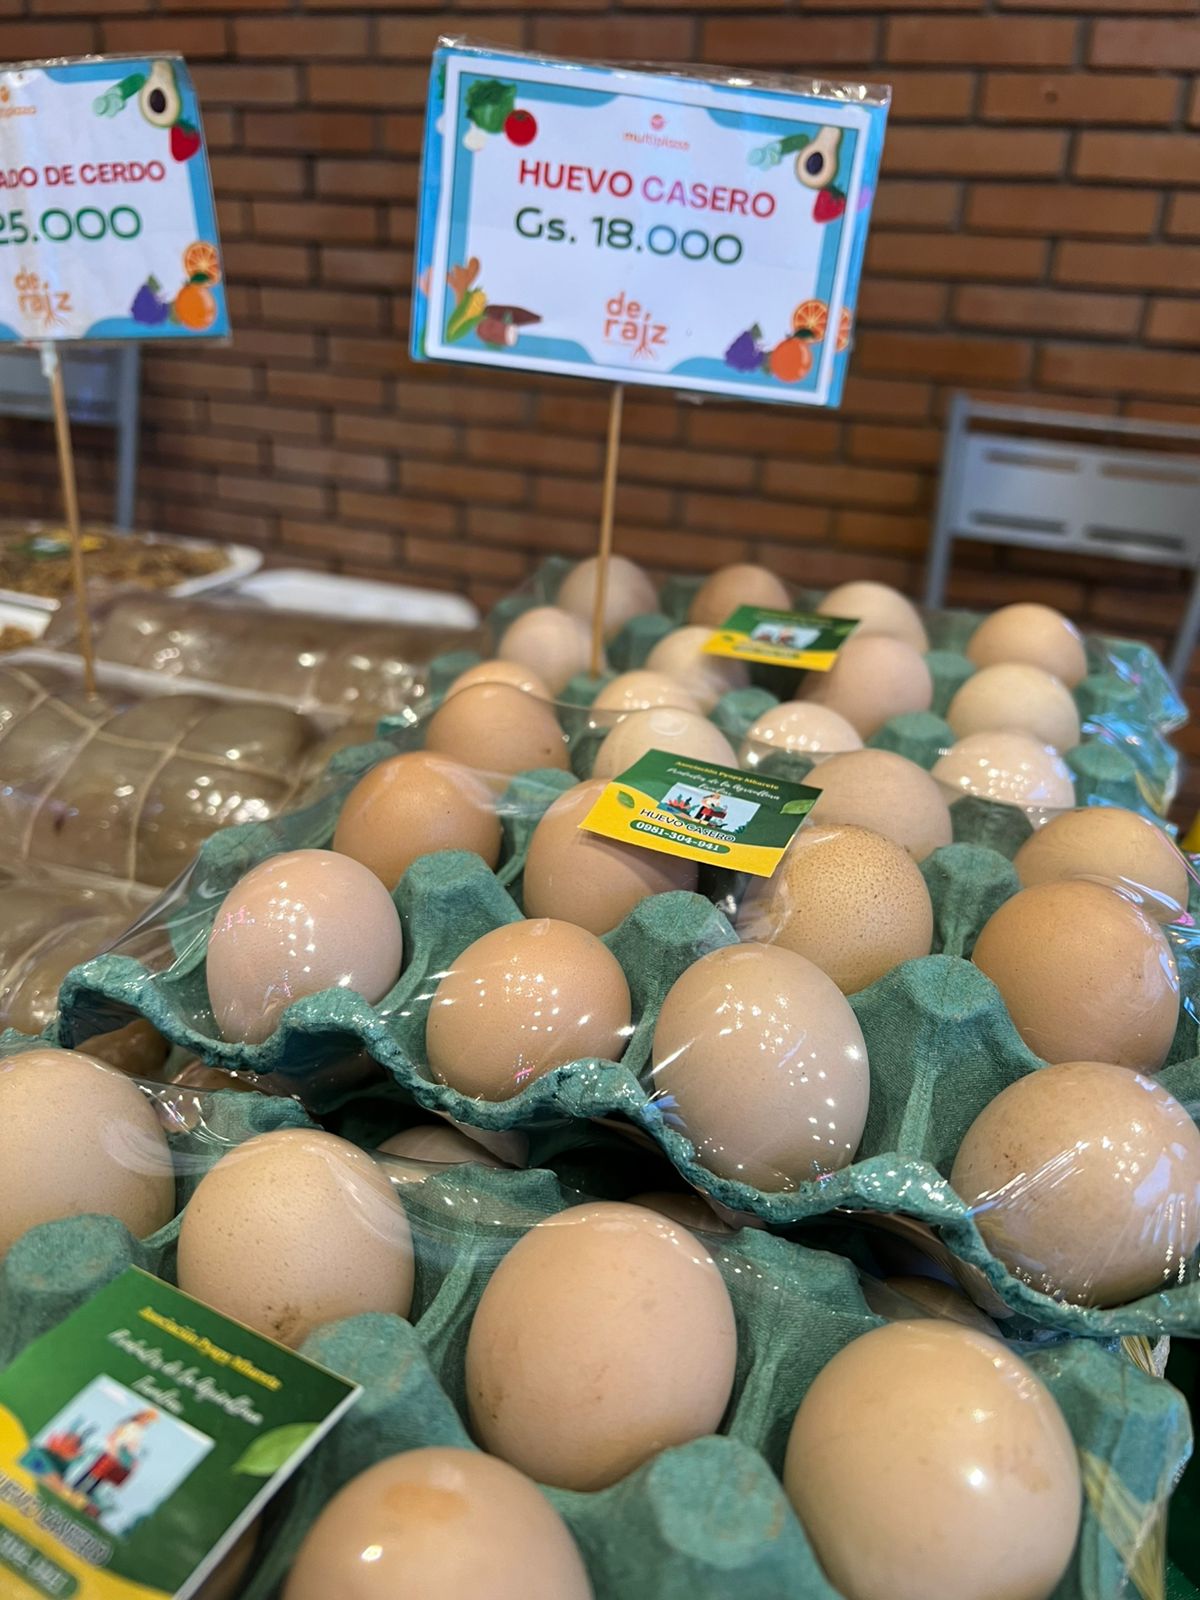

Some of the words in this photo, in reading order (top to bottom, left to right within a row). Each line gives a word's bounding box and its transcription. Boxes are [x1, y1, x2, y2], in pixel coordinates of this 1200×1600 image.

[45, 164, 75, 187] DE
[79, 159, 166, 185] CERDO
[518, 159, 633, 198] HUEVO
[640, 175, 776, 218] CASERO
[514, 206, 576, 244] Gs.
[592, 216, 743, 265] 18.000
[606, 290, 641, 319] de
[635, 820, 721, 852] 0981-304-941
[639, 807, 684, 829] HUEVO
[685, 822, 736, 843] CASERO
